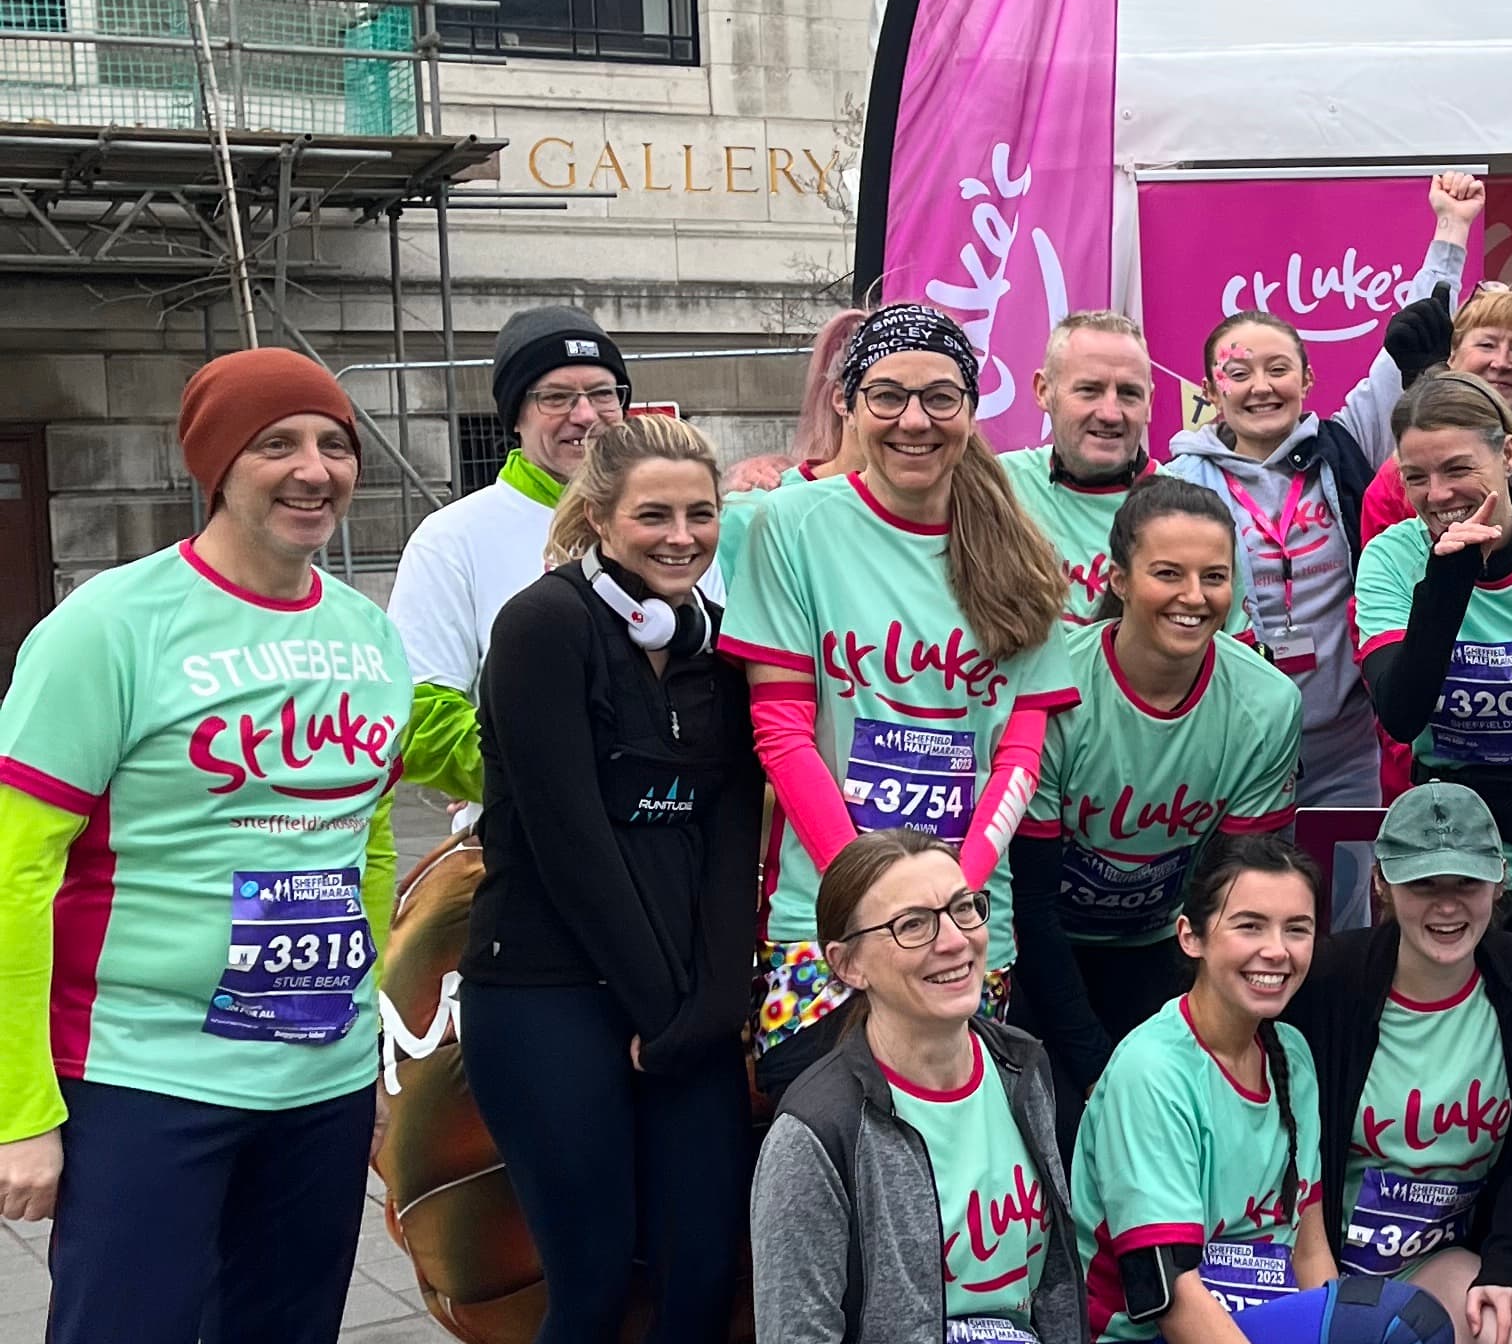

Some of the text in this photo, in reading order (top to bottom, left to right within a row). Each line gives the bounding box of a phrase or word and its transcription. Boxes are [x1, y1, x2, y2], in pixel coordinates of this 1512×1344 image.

[529, 137, 840, 195] GALLERY
[182, 640, 393, 697] STUIEBEAR
[822, 630, 878, 698] St
[188, 692, 396, 795] St Luke'
[906, 732, 952, 745] SHEFFIELD
[904, 742, 930, 755] HALF
[638, 798, 694, 811] RUNITUDE
[874, 778, 963, 820] 3754
[1109, 783, 1228, 840] Luke'
[904, 822, 938, 835] DAWN
[293, 888, 320, 901] HALF
[1071, 883, 1165, 908] 3405
[264, 930, 366, 973] 3318
[273, 975, 351, 988] STUIE BEAR
[1404, 1079, 1511, 1150] Luke
[1411, 1183, 1457, 1196] SHEFFIELD
[1409, 1194, 1434, 1204] HALF
[1376, 1222, 1455, 1257] 3625
[1208, 1244, 1252, 1256] SHEFFIELD
[1209, 1255, 1285, 1270] HALF MARATHON
[1256, 1270, 1285, 1285] 2023
